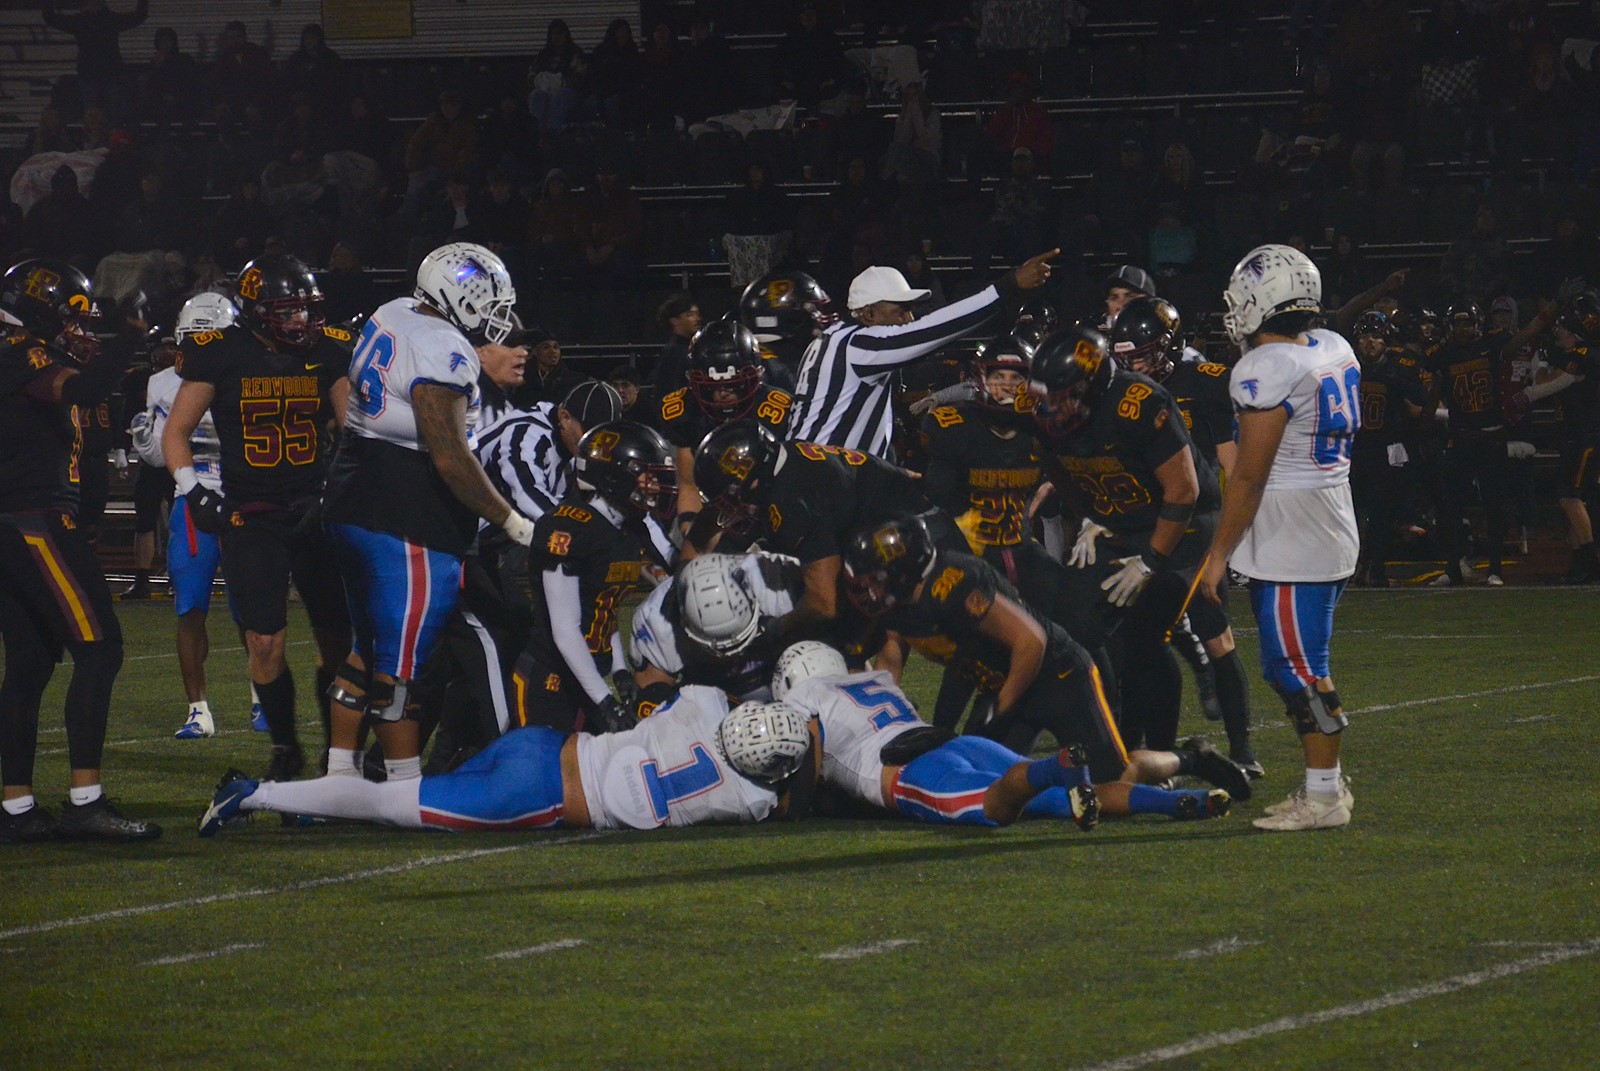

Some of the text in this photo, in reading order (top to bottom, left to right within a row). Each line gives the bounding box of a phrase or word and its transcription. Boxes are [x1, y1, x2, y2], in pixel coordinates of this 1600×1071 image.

[240, 376, 319, 398] REDWOODS
[757, 389, 794, 425] 30
[240, 397, 321, 468] 55
[834, 678, 921, 734] 5
[639, 741, 725, 824] 1
